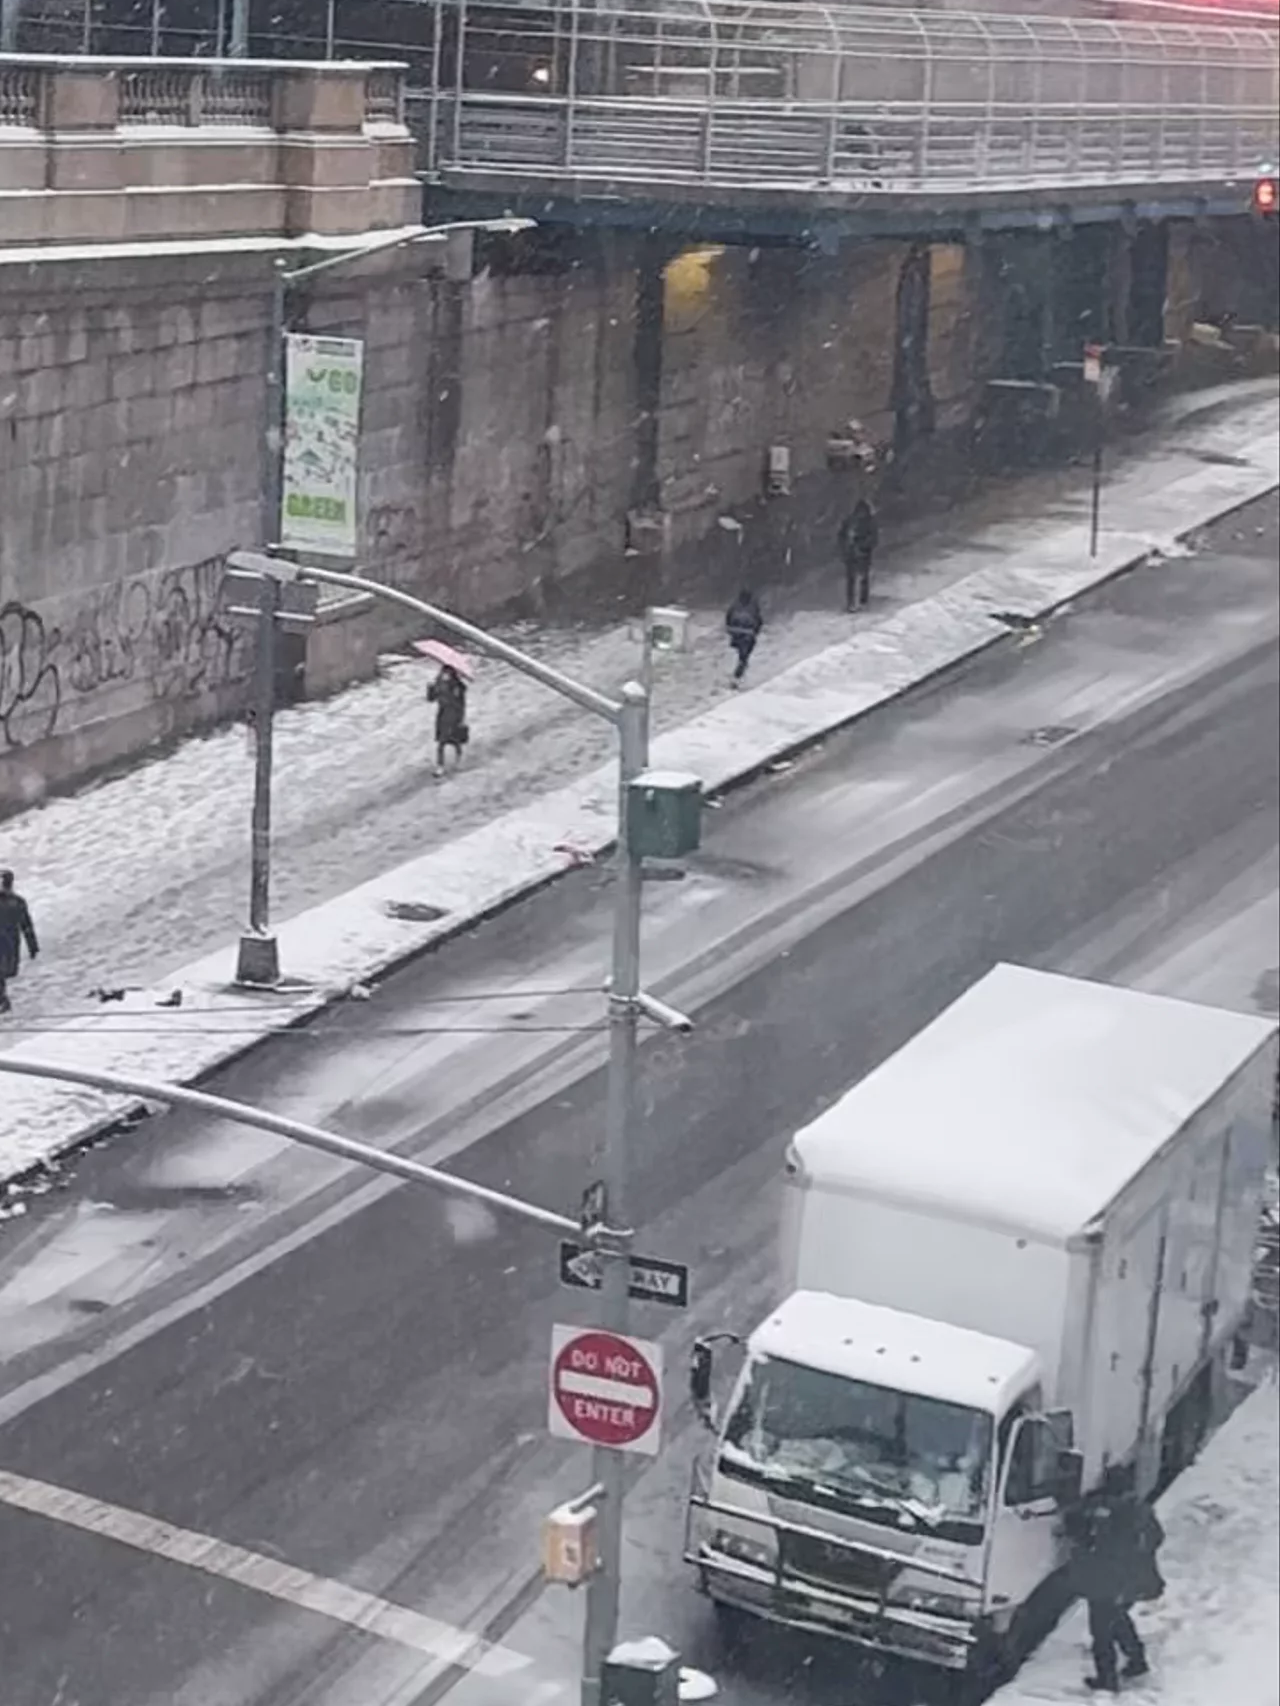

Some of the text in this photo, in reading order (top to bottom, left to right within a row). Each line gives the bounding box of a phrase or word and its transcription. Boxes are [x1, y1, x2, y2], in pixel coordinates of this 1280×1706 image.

[571, 1349, 642, 1378] DO NOT
[574, 1399, 635, 1428] ENTER
